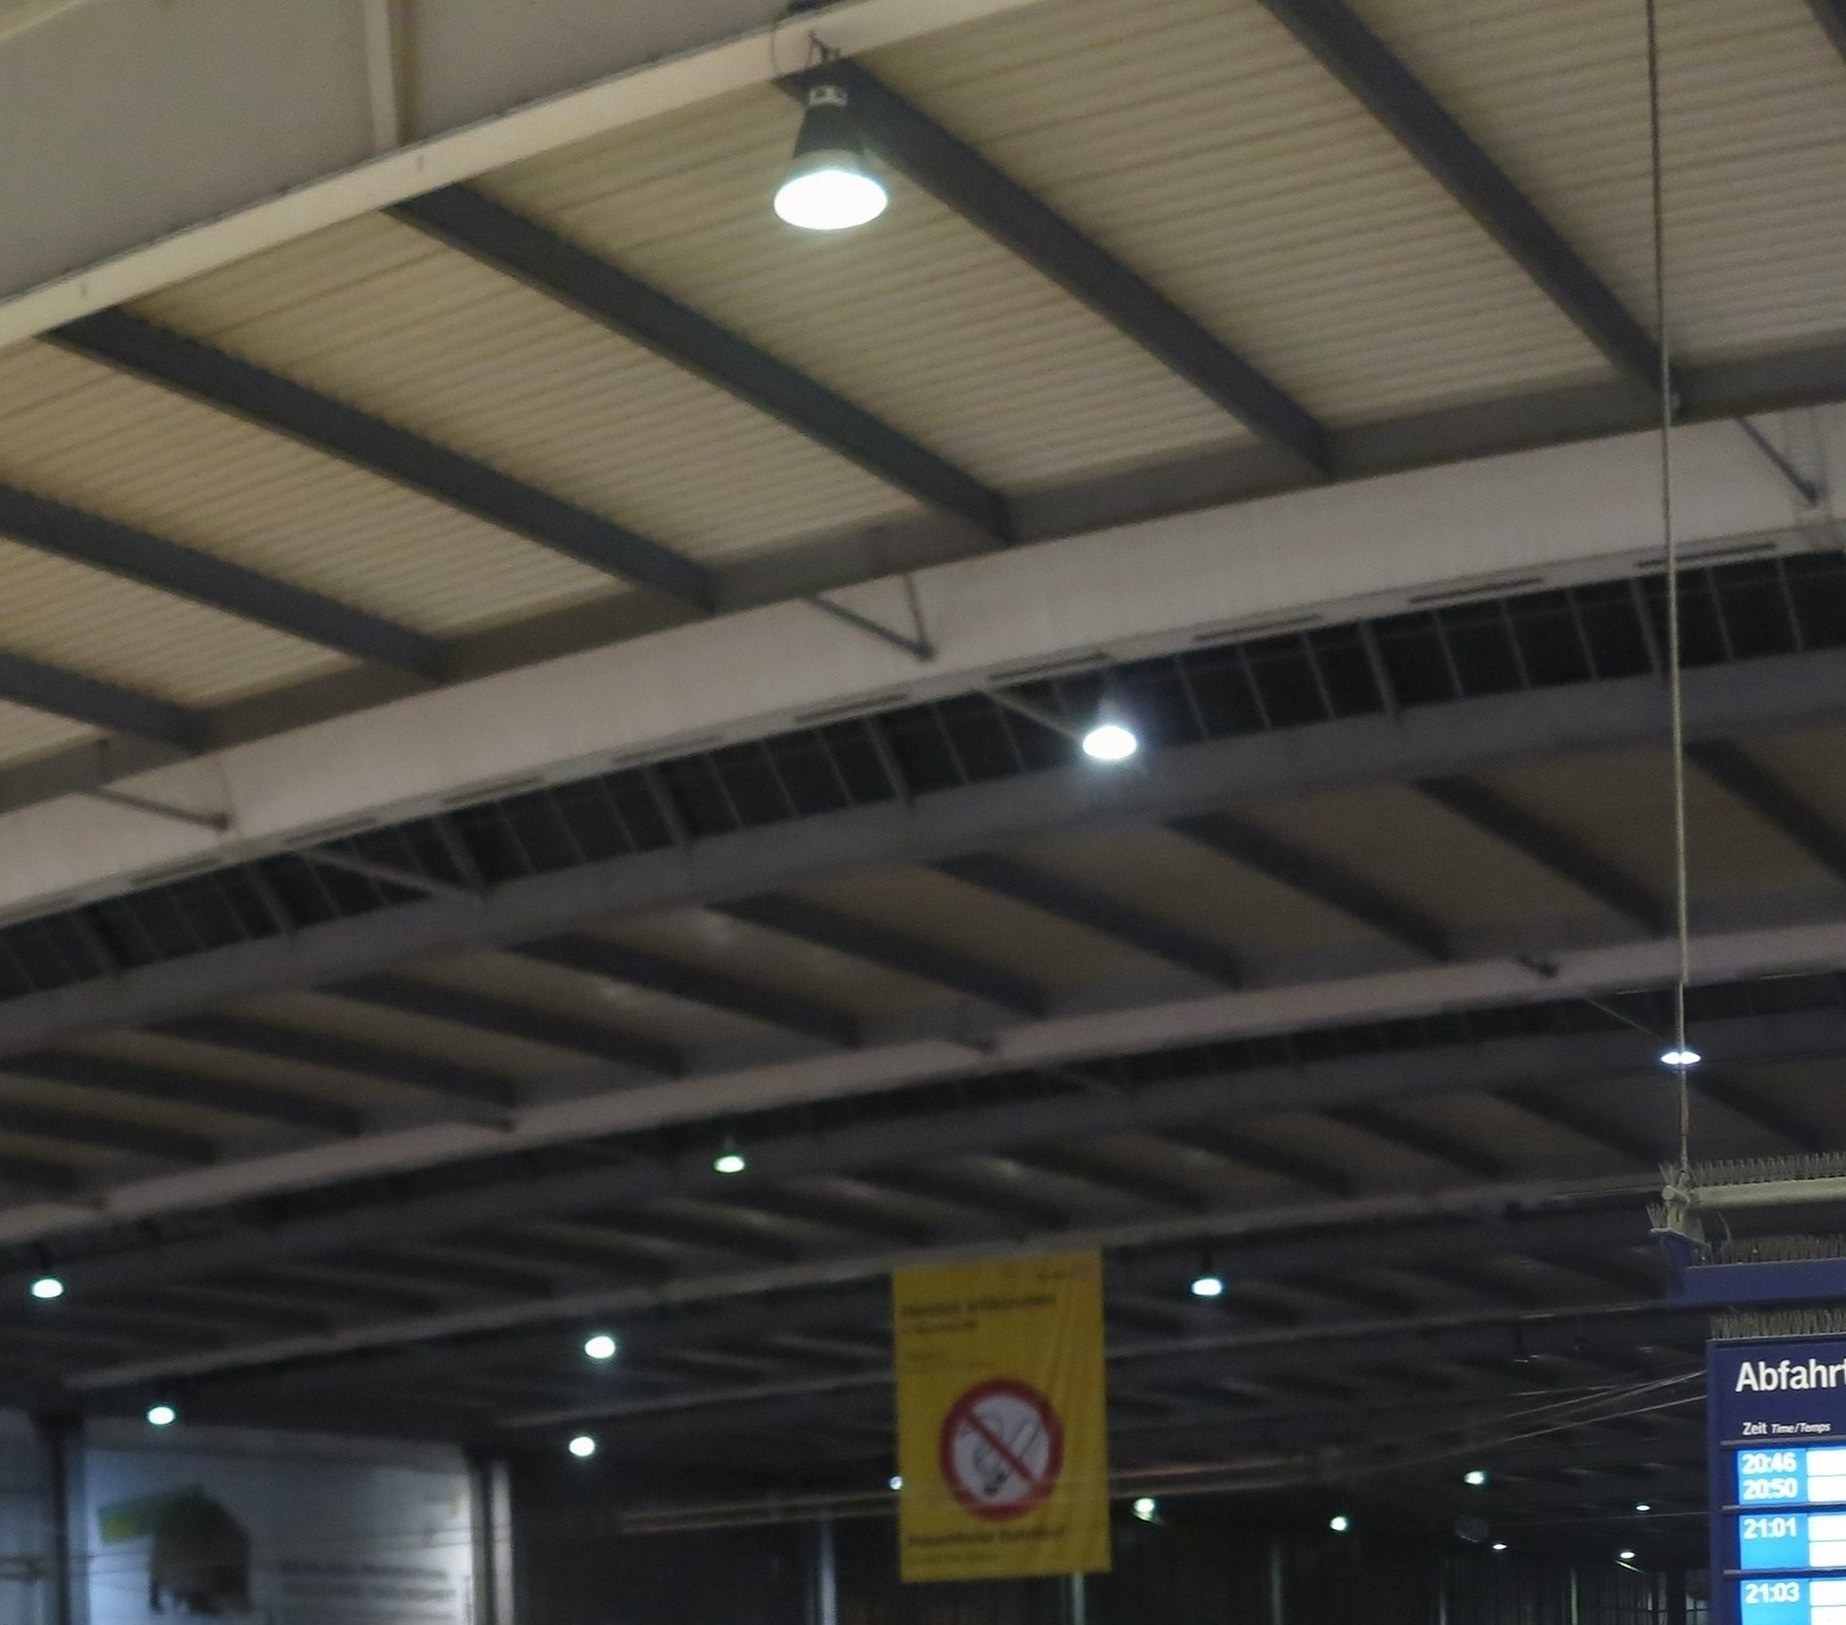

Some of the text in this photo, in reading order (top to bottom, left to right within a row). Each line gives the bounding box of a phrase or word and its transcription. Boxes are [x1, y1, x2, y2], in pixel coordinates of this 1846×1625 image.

[1742, 1421, 1767, 1435] Zeit
[1771, 1420, 1830, 1436] Time/Temps
[1742, 1453, 1796, 1475] 20:46
[1743, 1478, 1798, 1499] 20:50
[1744, 1517, 1797, 1539] 21:01
[1745, 1582, 1799, 1604] 21:03
